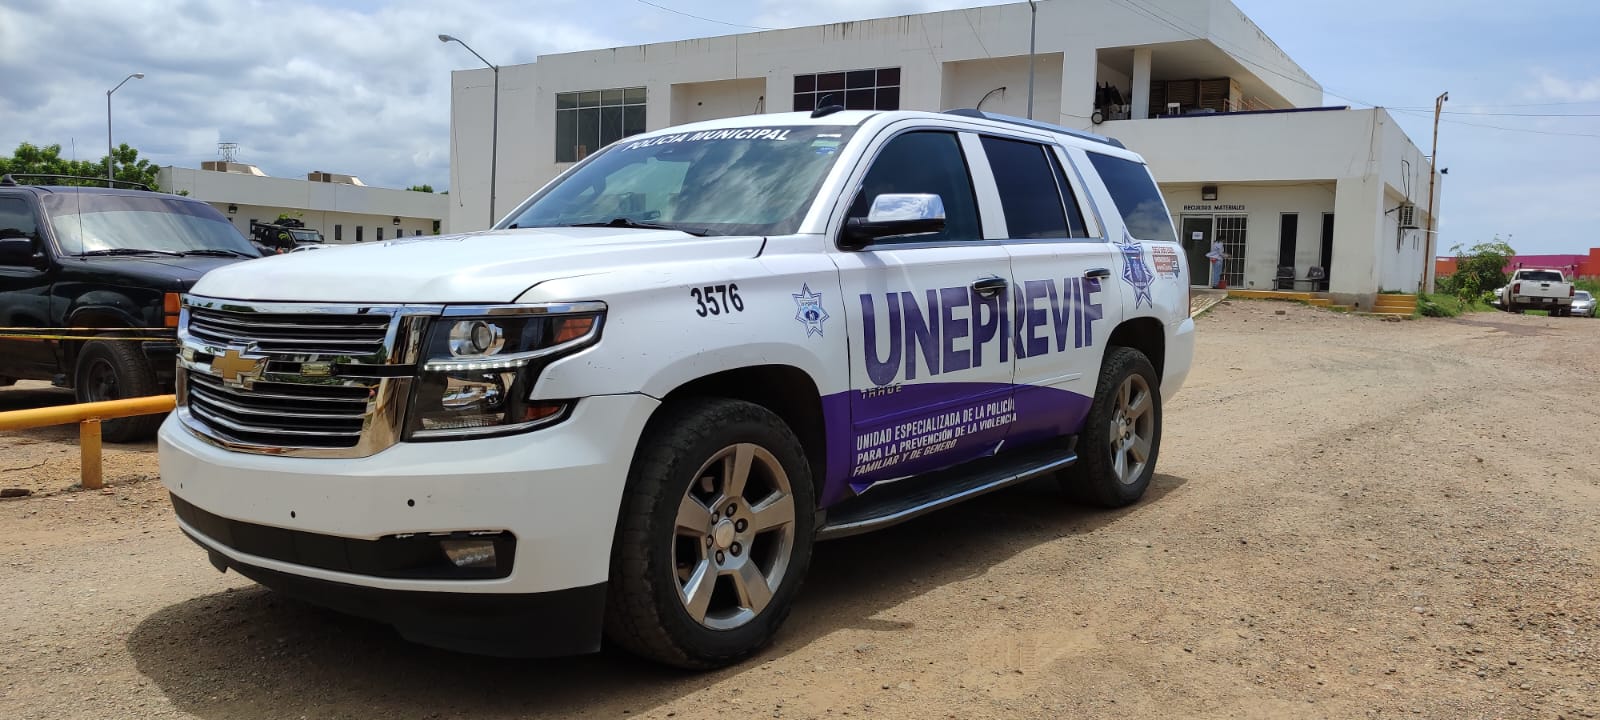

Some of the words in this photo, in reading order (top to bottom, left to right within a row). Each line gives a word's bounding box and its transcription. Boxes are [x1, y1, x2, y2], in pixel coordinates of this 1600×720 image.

[621, 134, 688, 151] POLICIA
[687, 129, 791, 141] MUNICIPAL
[691, 283, 744, 318] 3576
[860, 276, 1103, 386] UNEPREVIF
[857, 428, 892, 450] UNIDAD
[895, 412, 960, 439] ESPECIALIZADA
[963, 407, 974, 422] DE
[975, 404, 985, 419] LA
[857, 450, 882, 464] PARA
[885, 445, 897, 458] LA
[899, 428, 953, 453] PREVENCIÓN
[954, 425, 966, 438] DE
[968, 421, 978, 434] LA
[979, 412, 1017, 430] VIOLENCIA
[853, 455, 899, 477] FAMILIAR
[902, 452, 909, 462] Y
[910, 447, 921, 459] DE
[923, 438, 958, 457] GENERO
